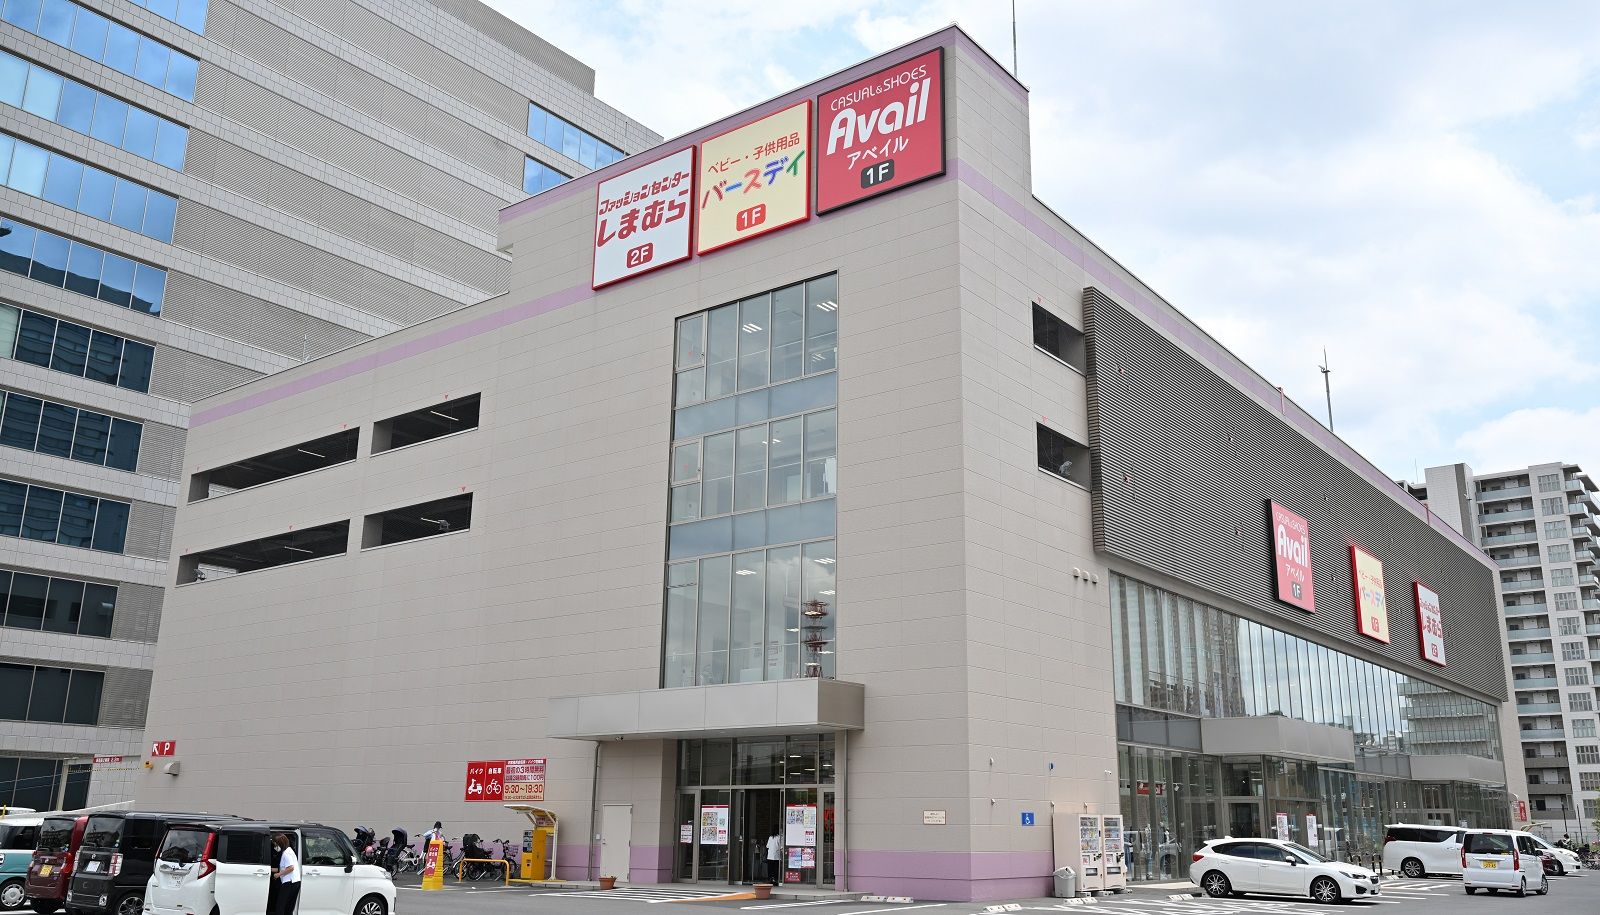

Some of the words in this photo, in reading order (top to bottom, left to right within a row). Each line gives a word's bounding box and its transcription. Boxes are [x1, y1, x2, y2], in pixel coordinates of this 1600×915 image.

[831, 65, 927, 111] CASUAL&SHOES
[826, 77, 931, 156] Avail
[708, 131, 800, 174] ベビー・子供用品
[847, 136, 909, 170] アベイル
[866, 162, 890, 185] 1F
[598, 171, 690, 215] ファッションセンター
[701, 150, 805, 209] バースデイ
[596, 189, 689, 248] しまむら
[741, 208, 762, 227] 1F
[630, 246, 650, 265] 2F
[1277, 524, 1308, 568] Avail
[1420, 612, 1443, 639] しまむら
[164, 742, 171, 756] P
